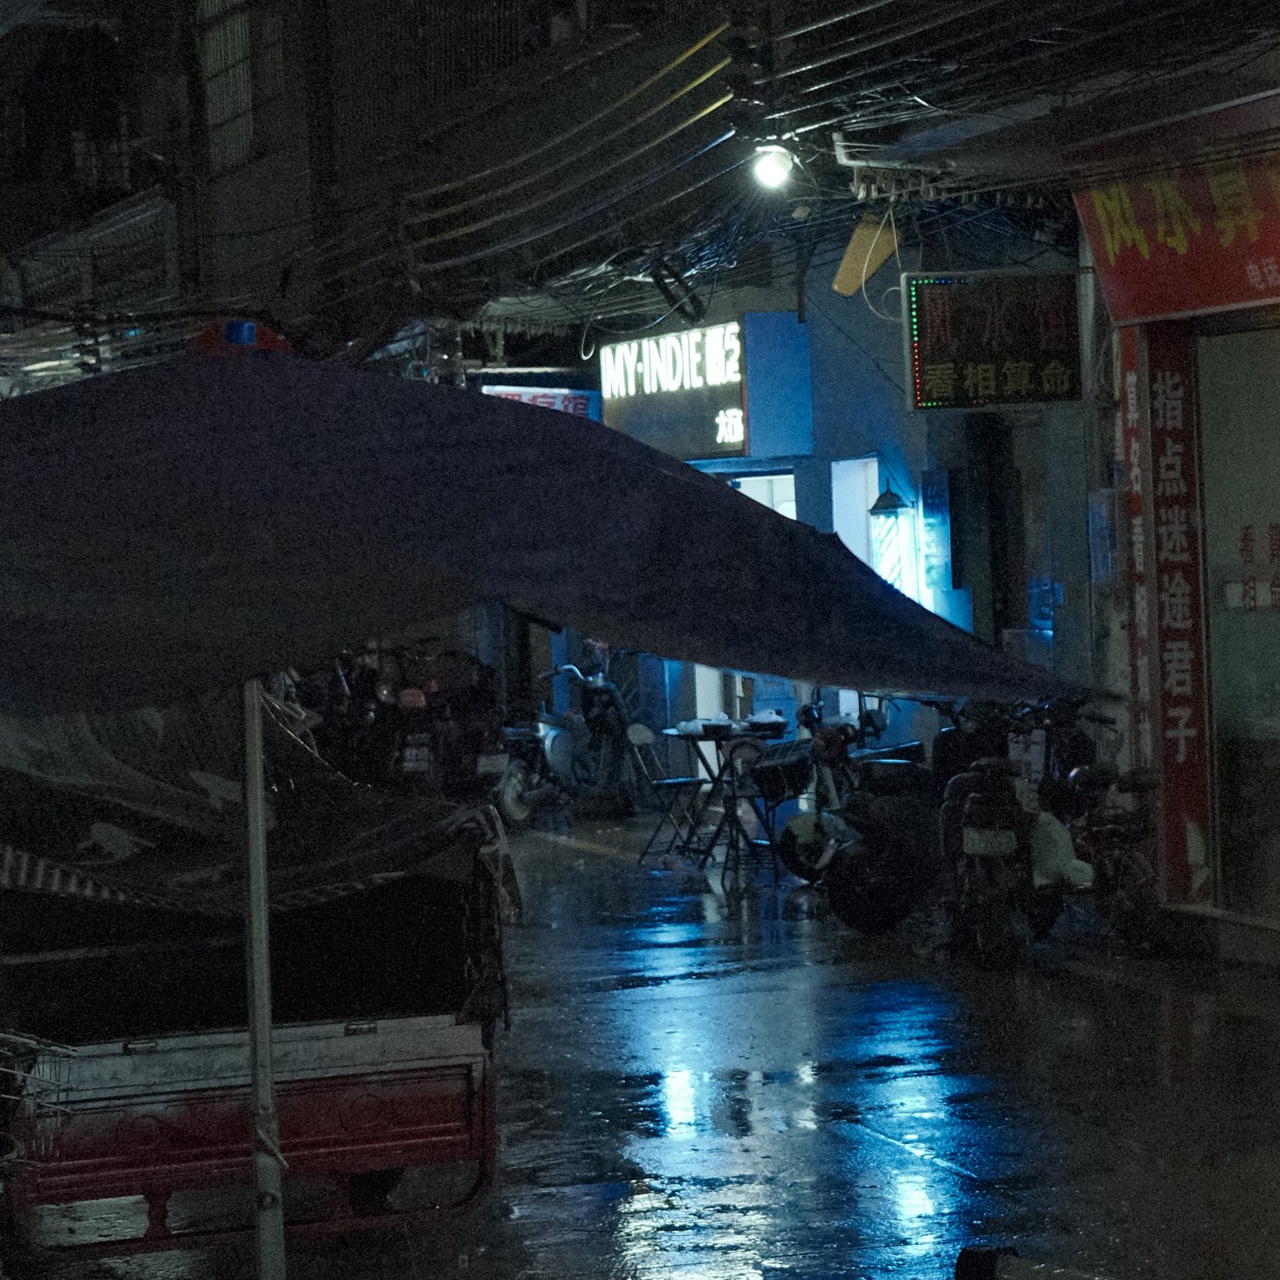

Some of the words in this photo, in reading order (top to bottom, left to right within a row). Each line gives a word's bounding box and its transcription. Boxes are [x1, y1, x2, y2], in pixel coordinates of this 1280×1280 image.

[922, 358, 1073, 399] 看相算命
[1153, 371, 1198, 764] 指点迷途君子
